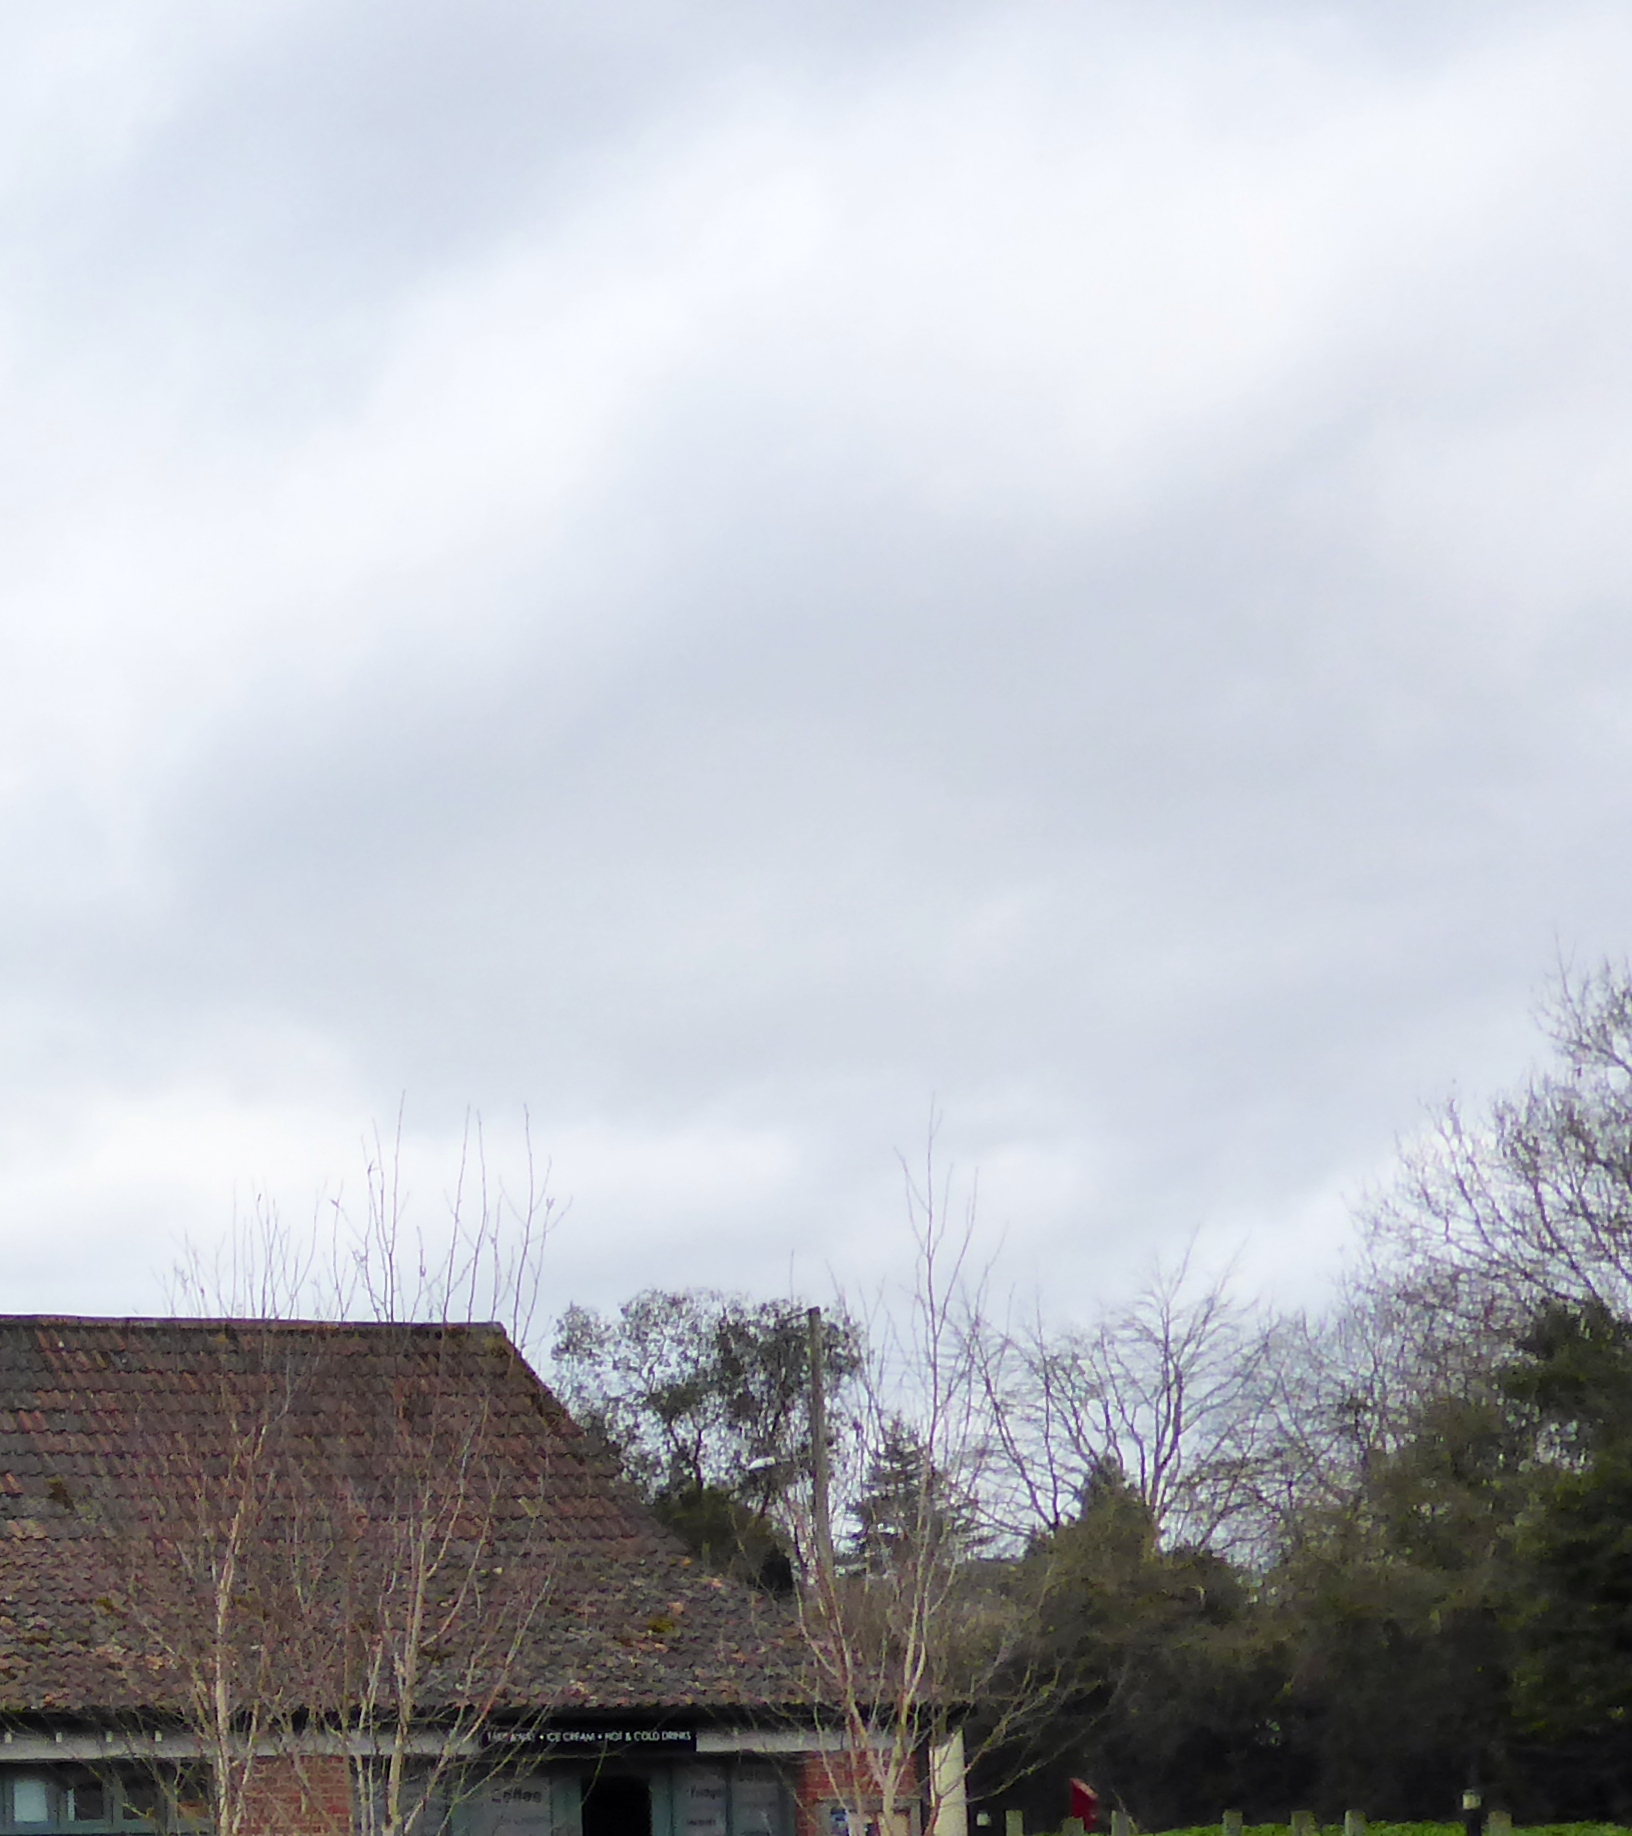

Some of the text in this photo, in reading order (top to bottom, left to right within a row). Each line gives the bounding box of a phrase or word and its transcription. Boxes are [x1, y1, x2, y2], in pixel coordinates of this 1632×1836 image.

[546, 1731, 561, 1742] ICE
[563, 1731, 596, 1742] CREAM
[633, 1731, 660, 1741] COLD
[661, 1730, 692, 1741] DRINKS
